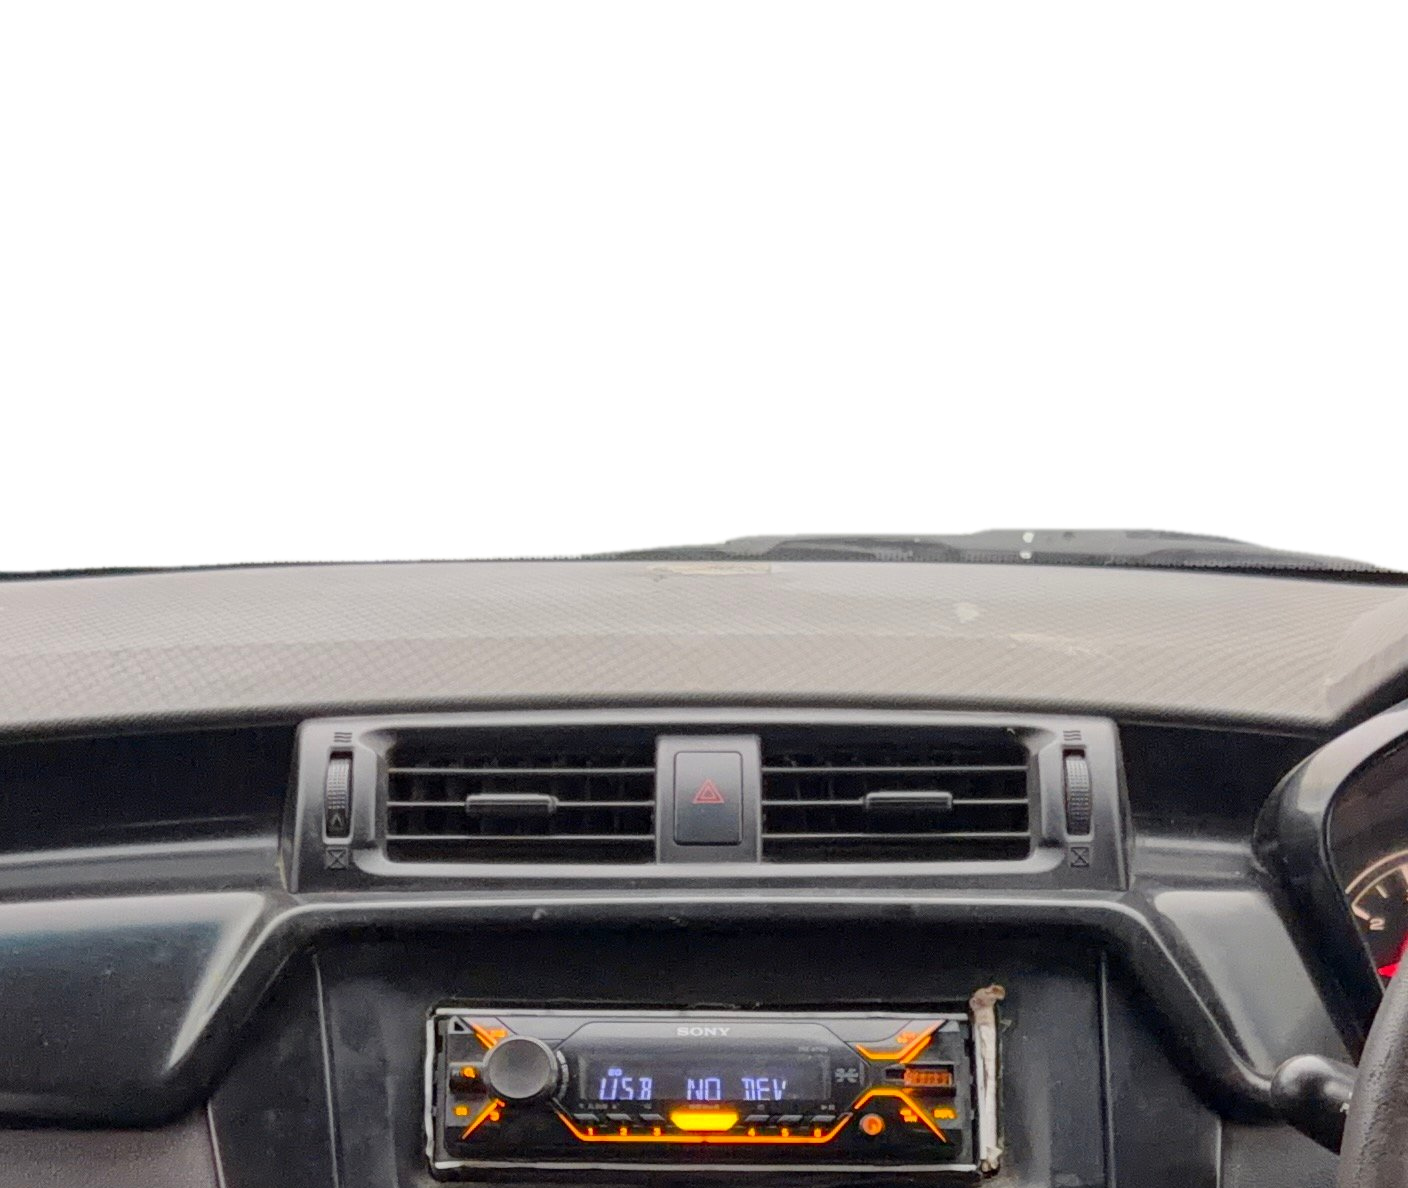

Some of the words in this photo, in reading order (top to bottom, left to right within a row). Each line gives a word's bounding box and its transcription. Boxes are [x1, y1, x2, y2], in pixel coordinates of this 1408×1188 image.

[1369, 918, 1385, 931] 2
[676, 1026, 731, 1037] SONY
[599, 1077, 653, 1101] USB
[687, 1077, 721, 1101] NO
[741, 1077, 787, 1101] DEV
